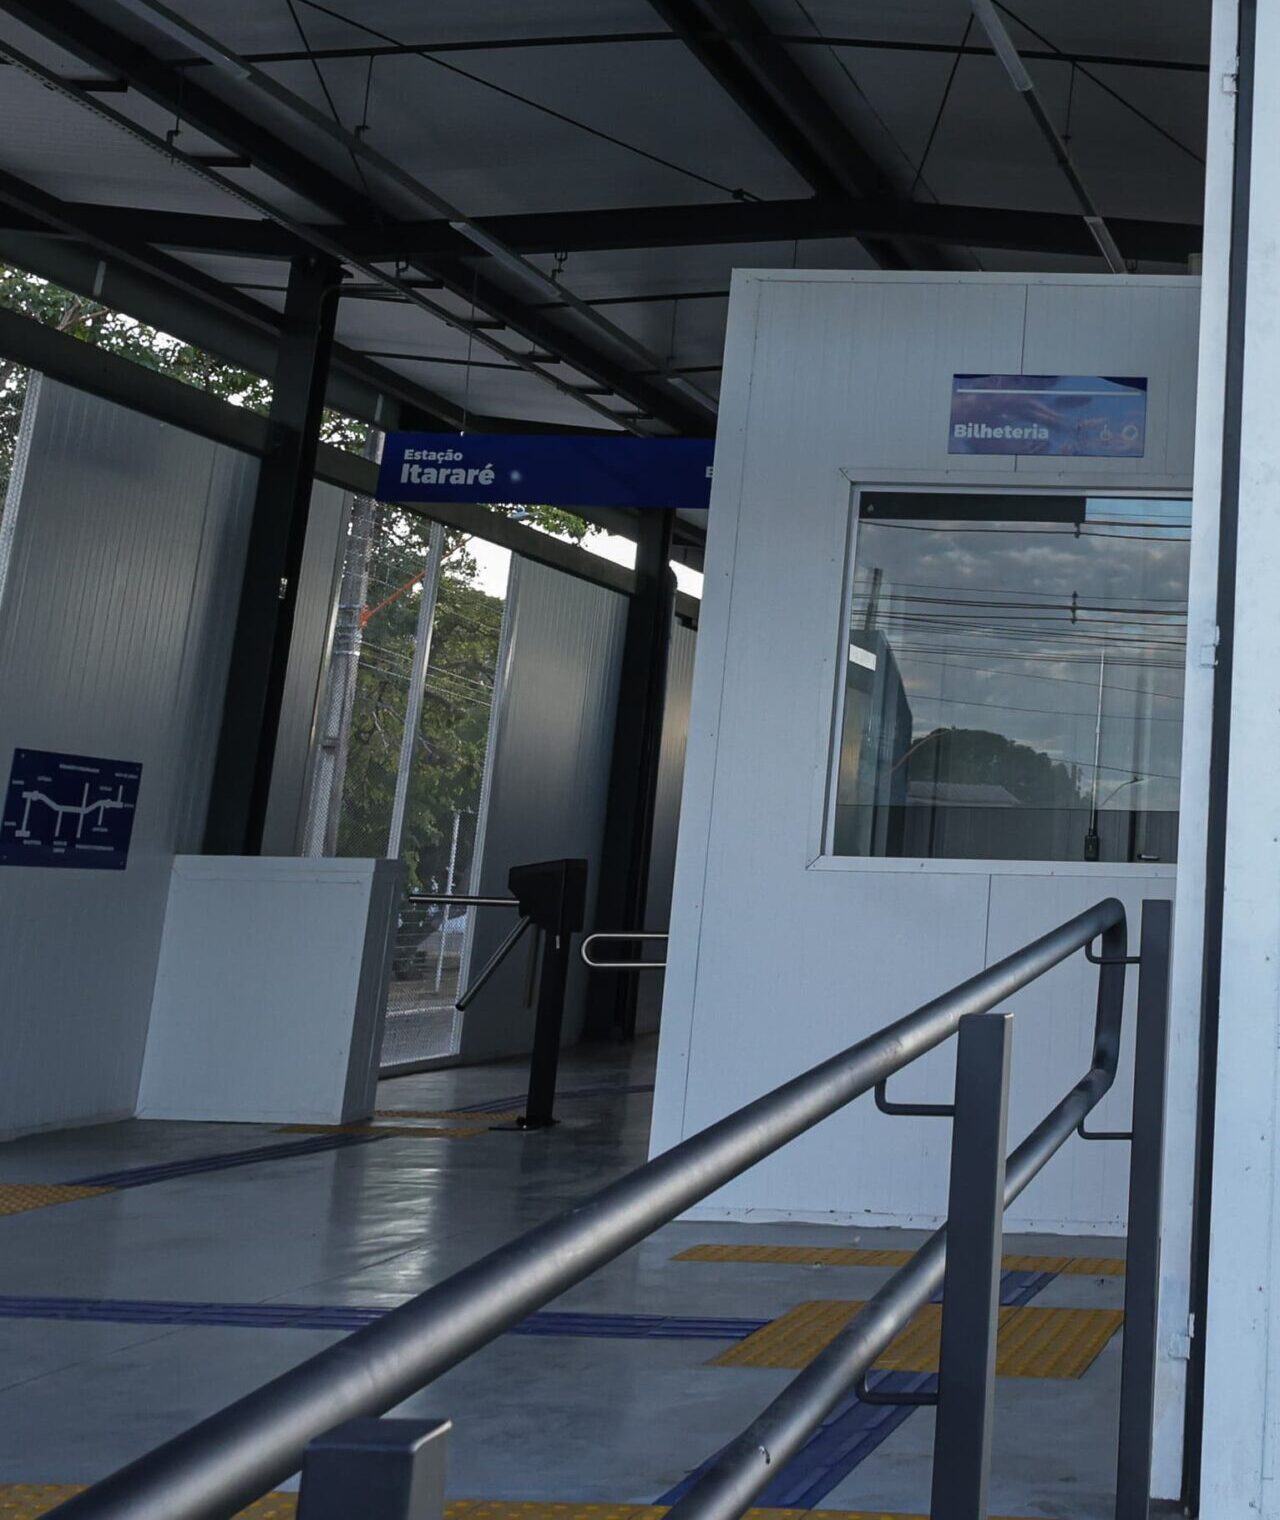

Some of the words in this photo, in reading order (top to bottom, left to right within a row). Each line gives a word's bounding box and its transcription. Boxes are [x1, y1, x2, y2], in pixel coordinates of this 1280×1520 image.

[954, 422, 1049, 439] Bilheteria
[404, 449, 463, 464] Estação
[400, 463, 496, 485] Itararé
